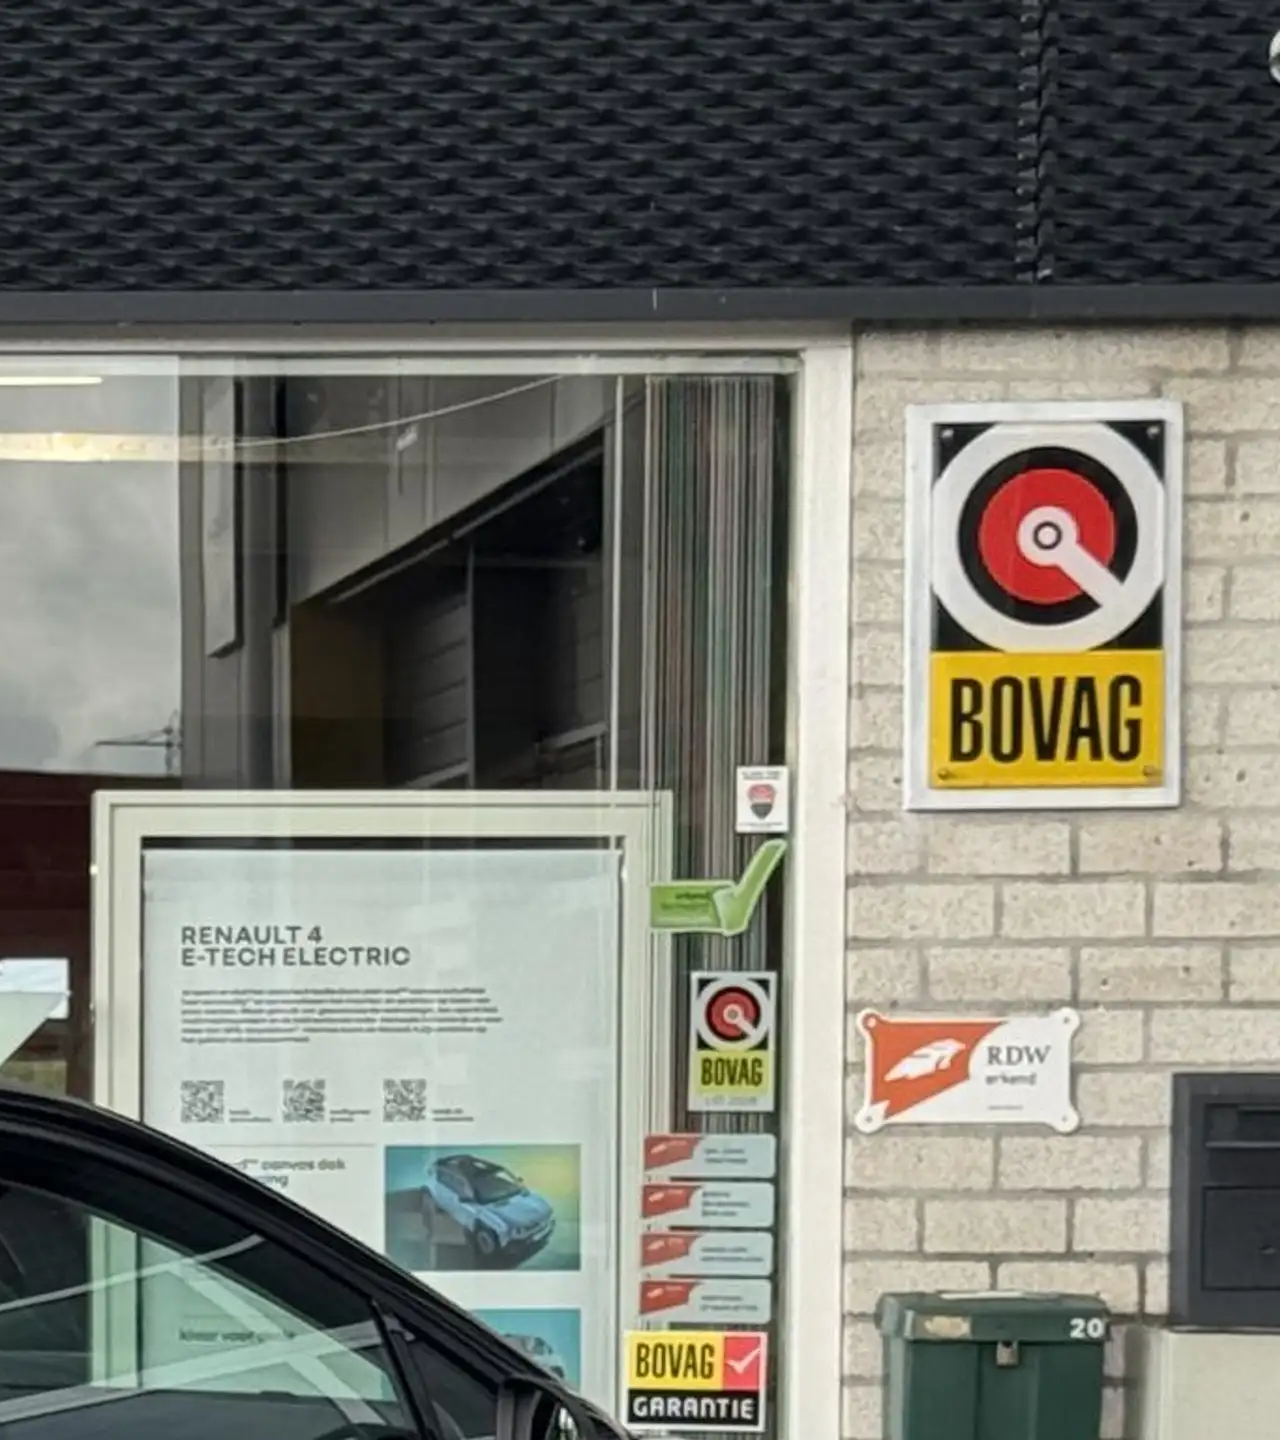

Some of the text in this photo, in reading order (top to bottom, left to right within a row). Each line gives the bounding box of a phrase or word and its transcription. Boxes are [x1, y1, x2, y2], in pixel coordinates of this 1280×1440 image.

[950, 674, 1143, 763] BOVAG
[181, 925, 323, 945] RENAULT 4
[181, 946, 411, 966] E-TECH ELECTRIC
[987, 1044, 1052, 1066] RDW
[700, 1056, 763, 1087] BOVAG
[1069, 1316, 1106, 1339] 20
[635, 1342, 716, 1380] BOVAG
[632, 1396, 756, 1420] GARANTIE
